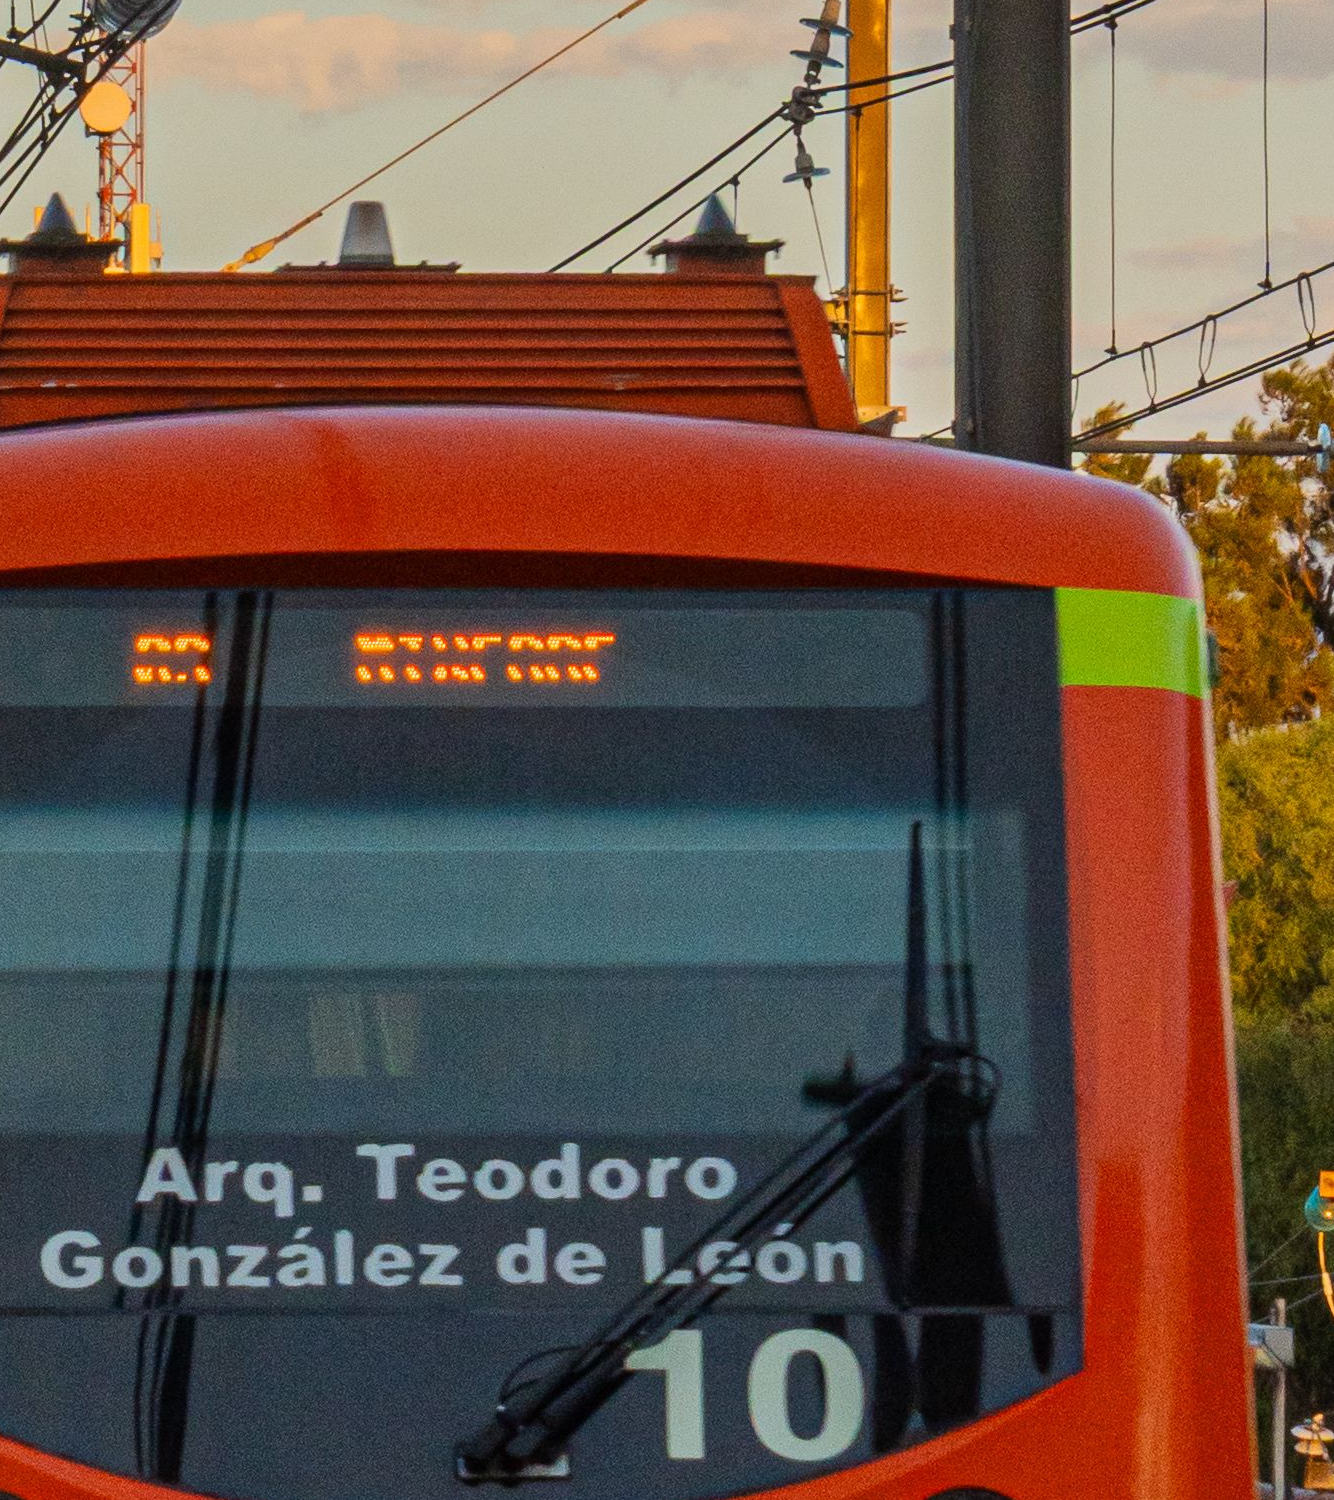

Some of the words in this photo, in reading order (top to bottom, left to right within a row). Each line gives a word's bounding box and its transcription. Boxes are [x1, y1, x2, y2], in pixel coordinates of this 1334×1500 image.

[135, 1146, 324, 1219] Arq.
[356, 1143, 738, 1202] Teodoro
[40, 1225, 465, 1289] González
[496, 1227, 608, 1285] de
[642, 1222, 865, 1286] León
[622, 1328, 865, 1462] 10
